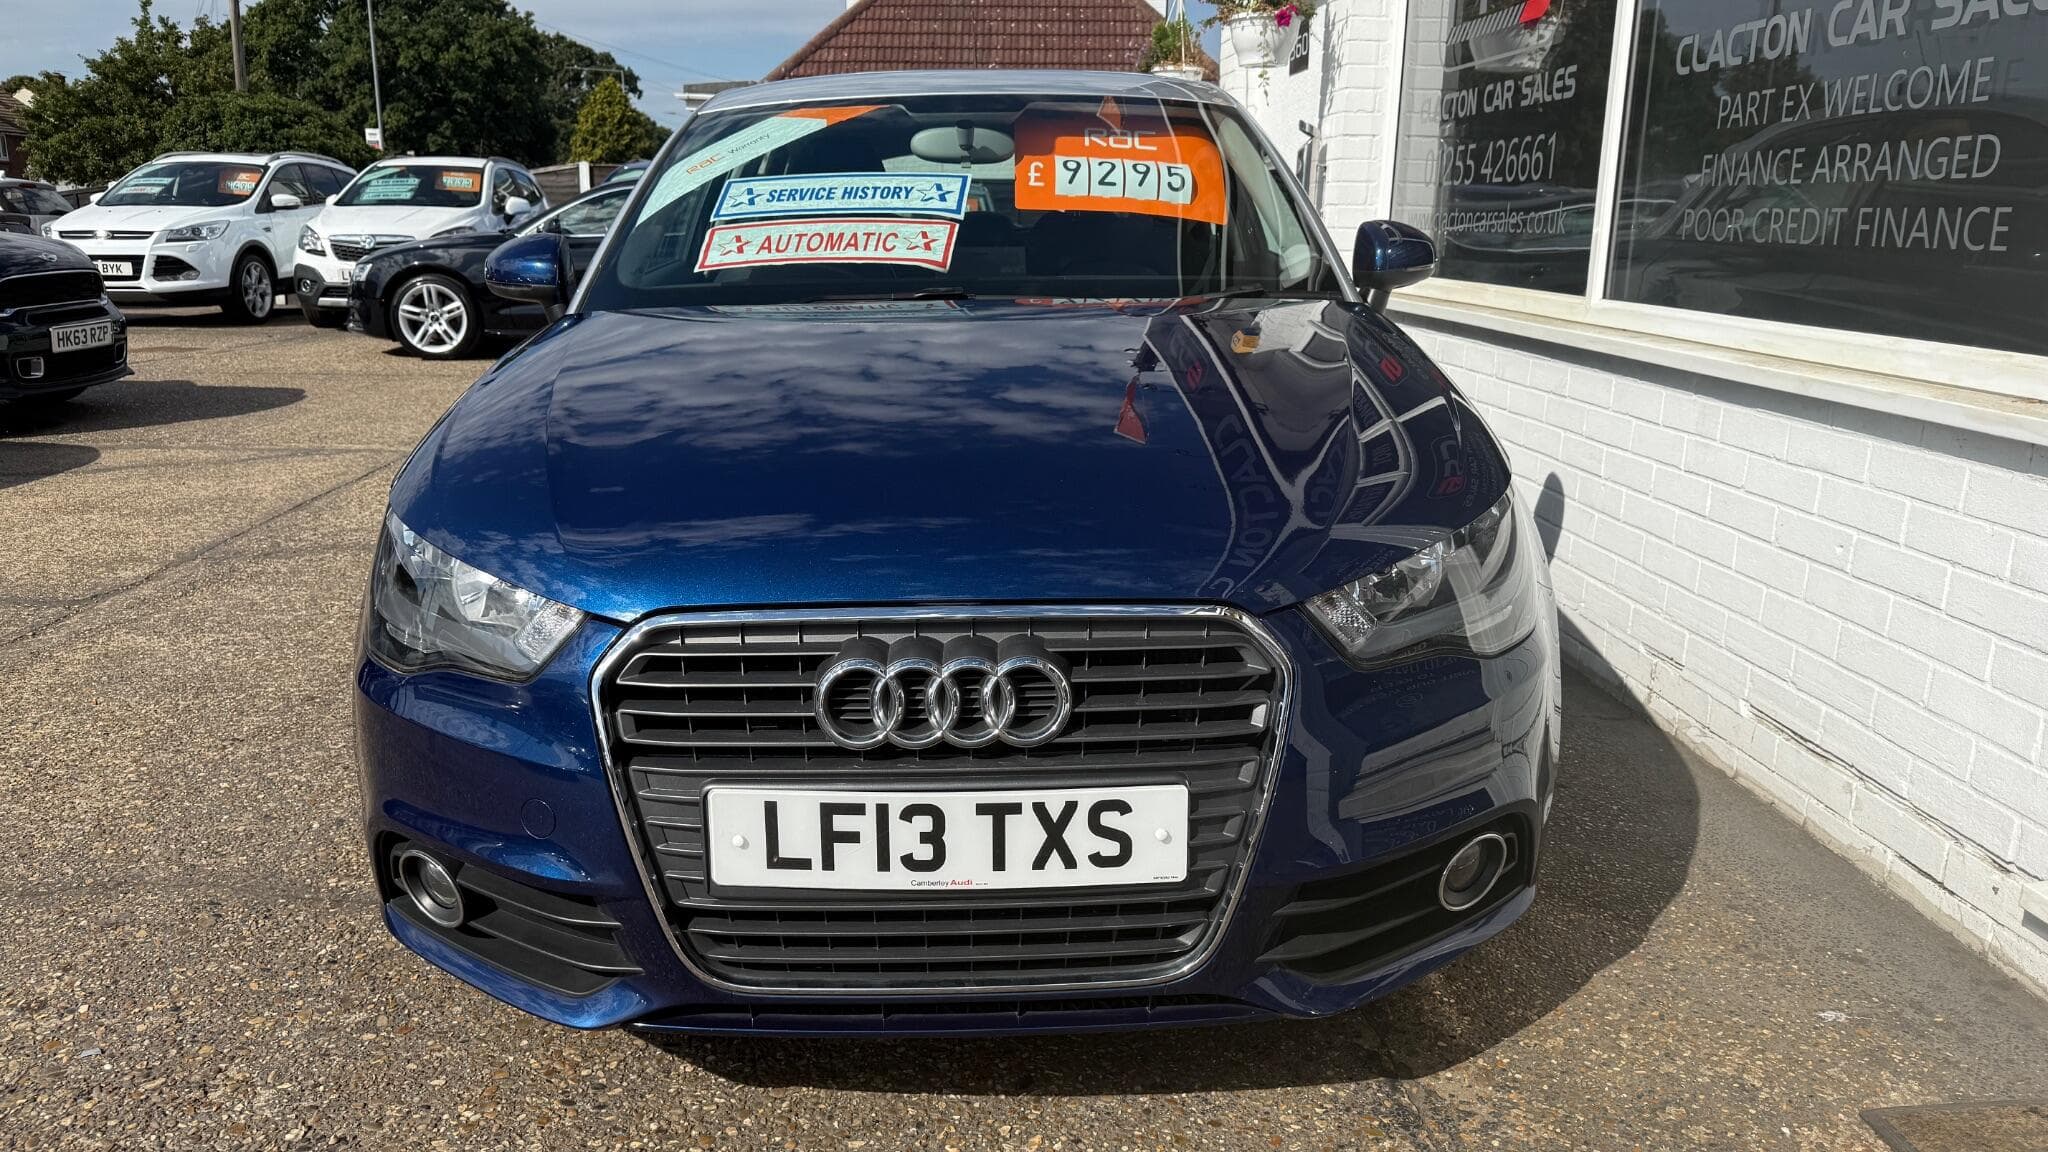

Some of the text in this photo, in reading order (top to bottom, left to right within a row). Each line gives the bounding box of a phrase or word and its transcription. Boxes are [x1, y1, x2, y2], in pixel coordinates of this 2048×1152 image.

[1676, 8, 1812, 75] CLACTON
[1828, 0, 1907, 47] CAR
[1484, 79, 1515, 113] CAR
[1521, 64, 1578, 107] SALES
[1717, 57, 1995, 129] PART EX WELCOME
[727, 133, 770, 154] Warranty
[1480, 131, 1557, 183] 426661
[1700, 134, 2001, 187] FINANCE ARRANGED
[766, 185, 915, 203] SERVICE HISTORY
[756, 231, 900, 255] AUTOMATIC
[1682, 206, 2013, 252] POOR CREDIT FINANCE
[102, 264, 123, 274] BYK
[57, 326, 109, 349] HK63 RZP
[764, 798, 1134, 873] LF13 TXS
[910, 879, 949, 888] Camberley
